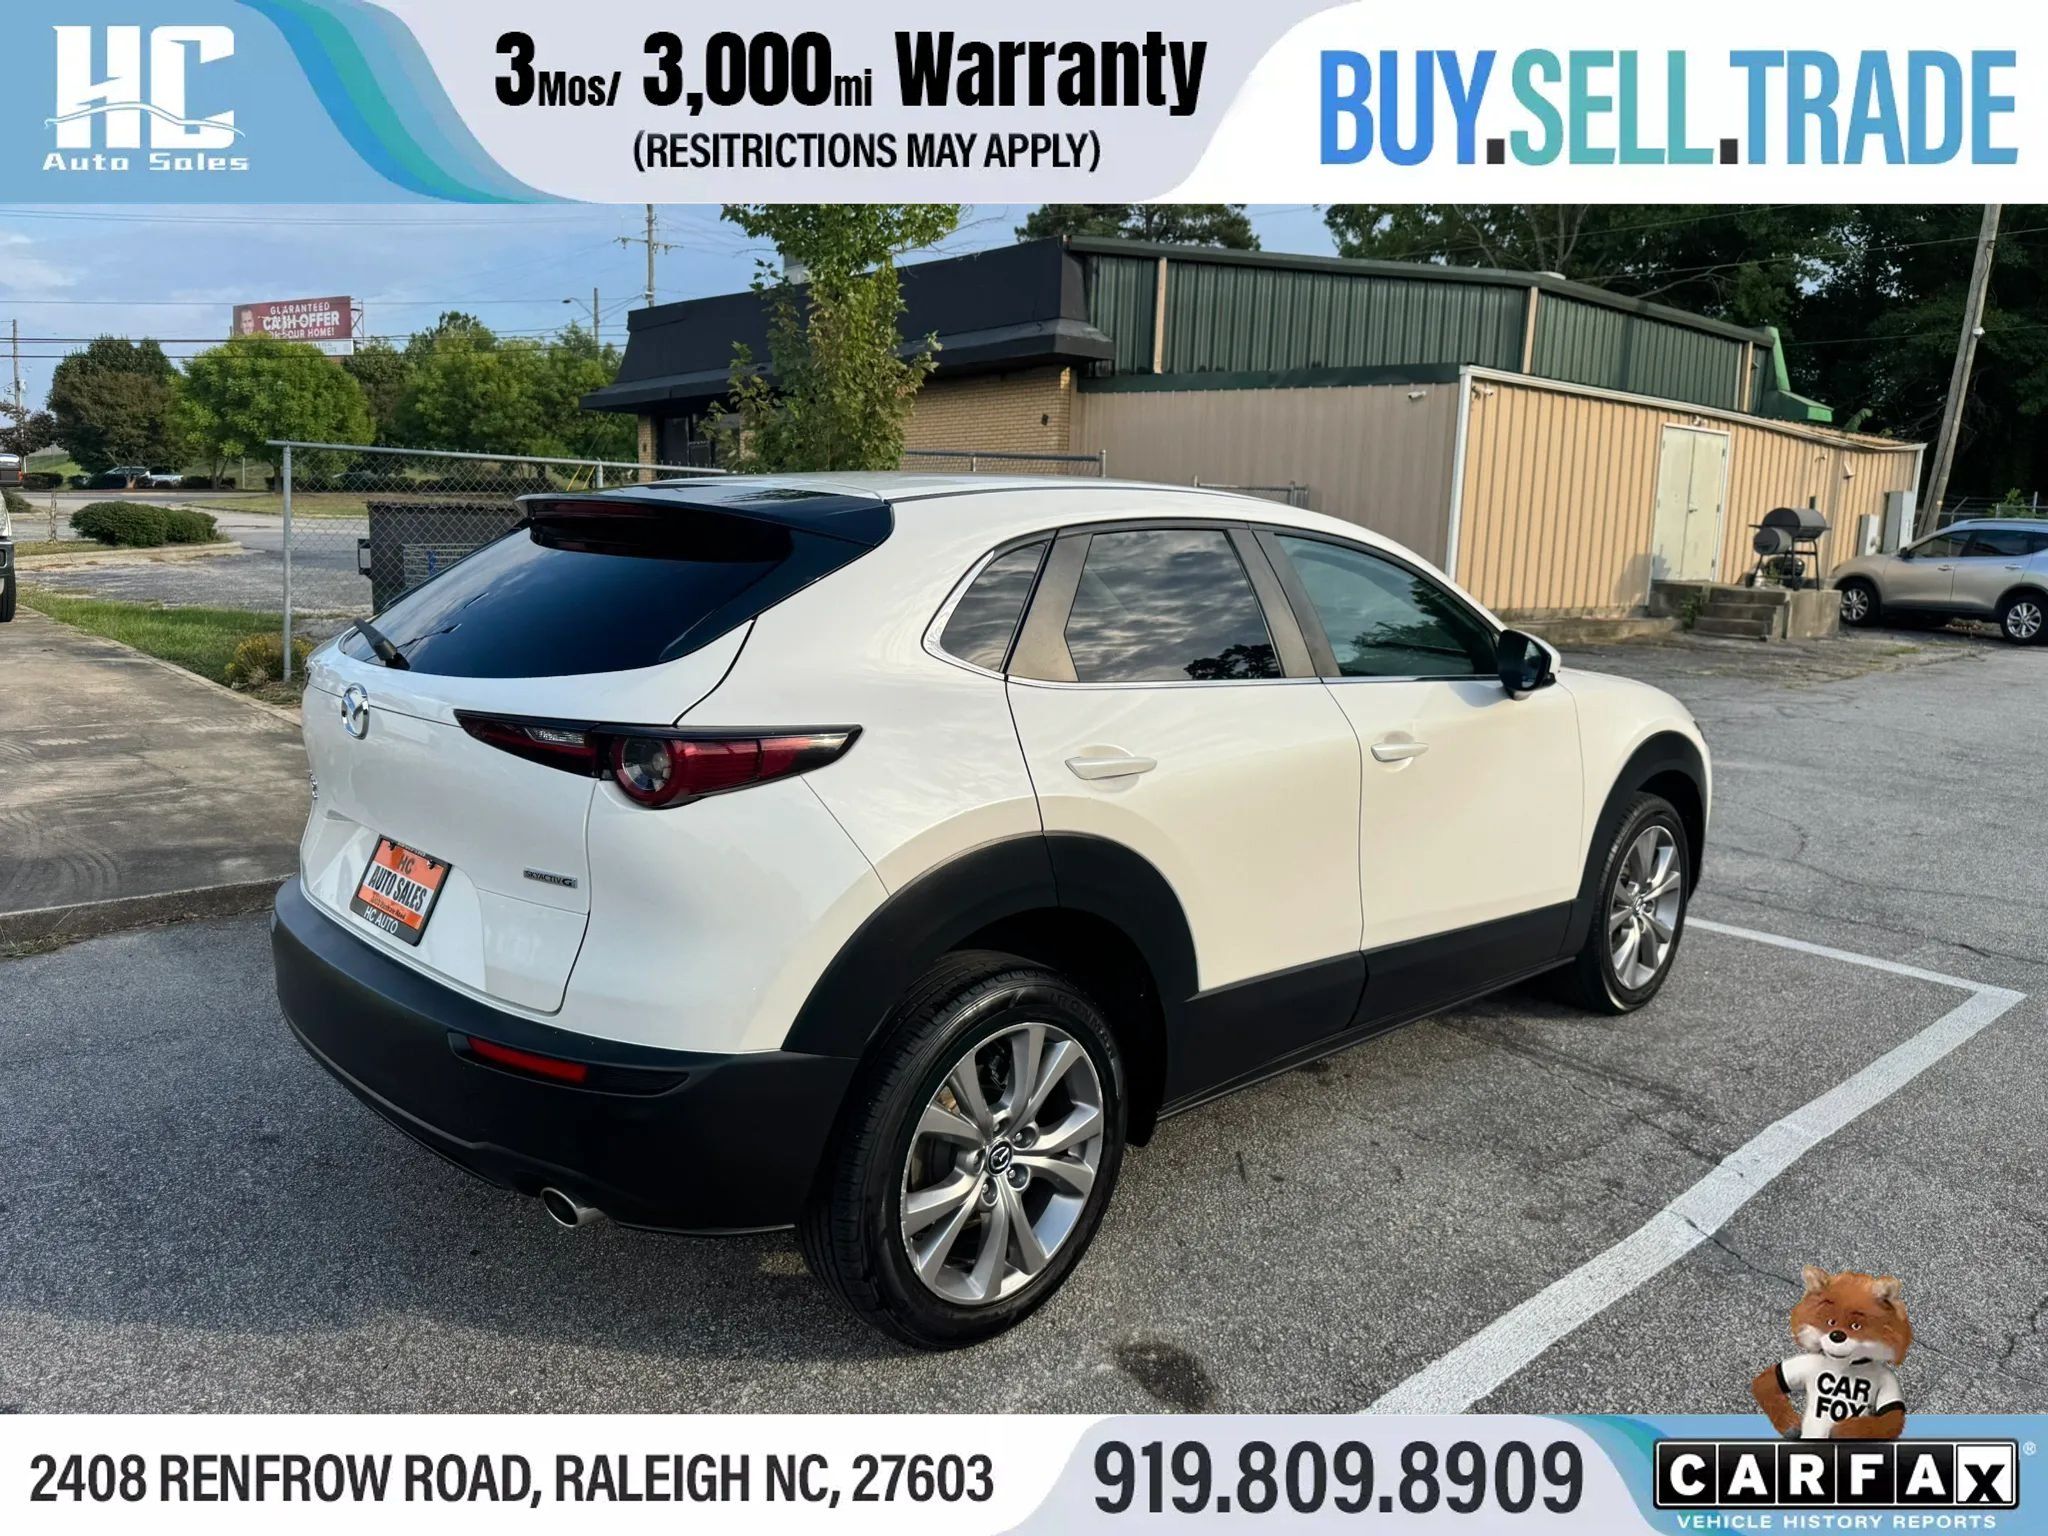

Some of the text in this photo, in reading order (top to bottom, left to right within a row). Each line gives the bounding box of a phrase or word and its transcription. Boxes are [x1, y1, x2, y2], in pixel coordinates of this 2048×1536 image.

[299, 311, 340, 328] OFFER
[307, 327, 335, 337] HOME!
[396, 854, 415, 875] HC
[368, 865, 398, 896] AUTO
[393, 877, 428, 912] SALES
[364, 906, 399, 934] HC AUTO
